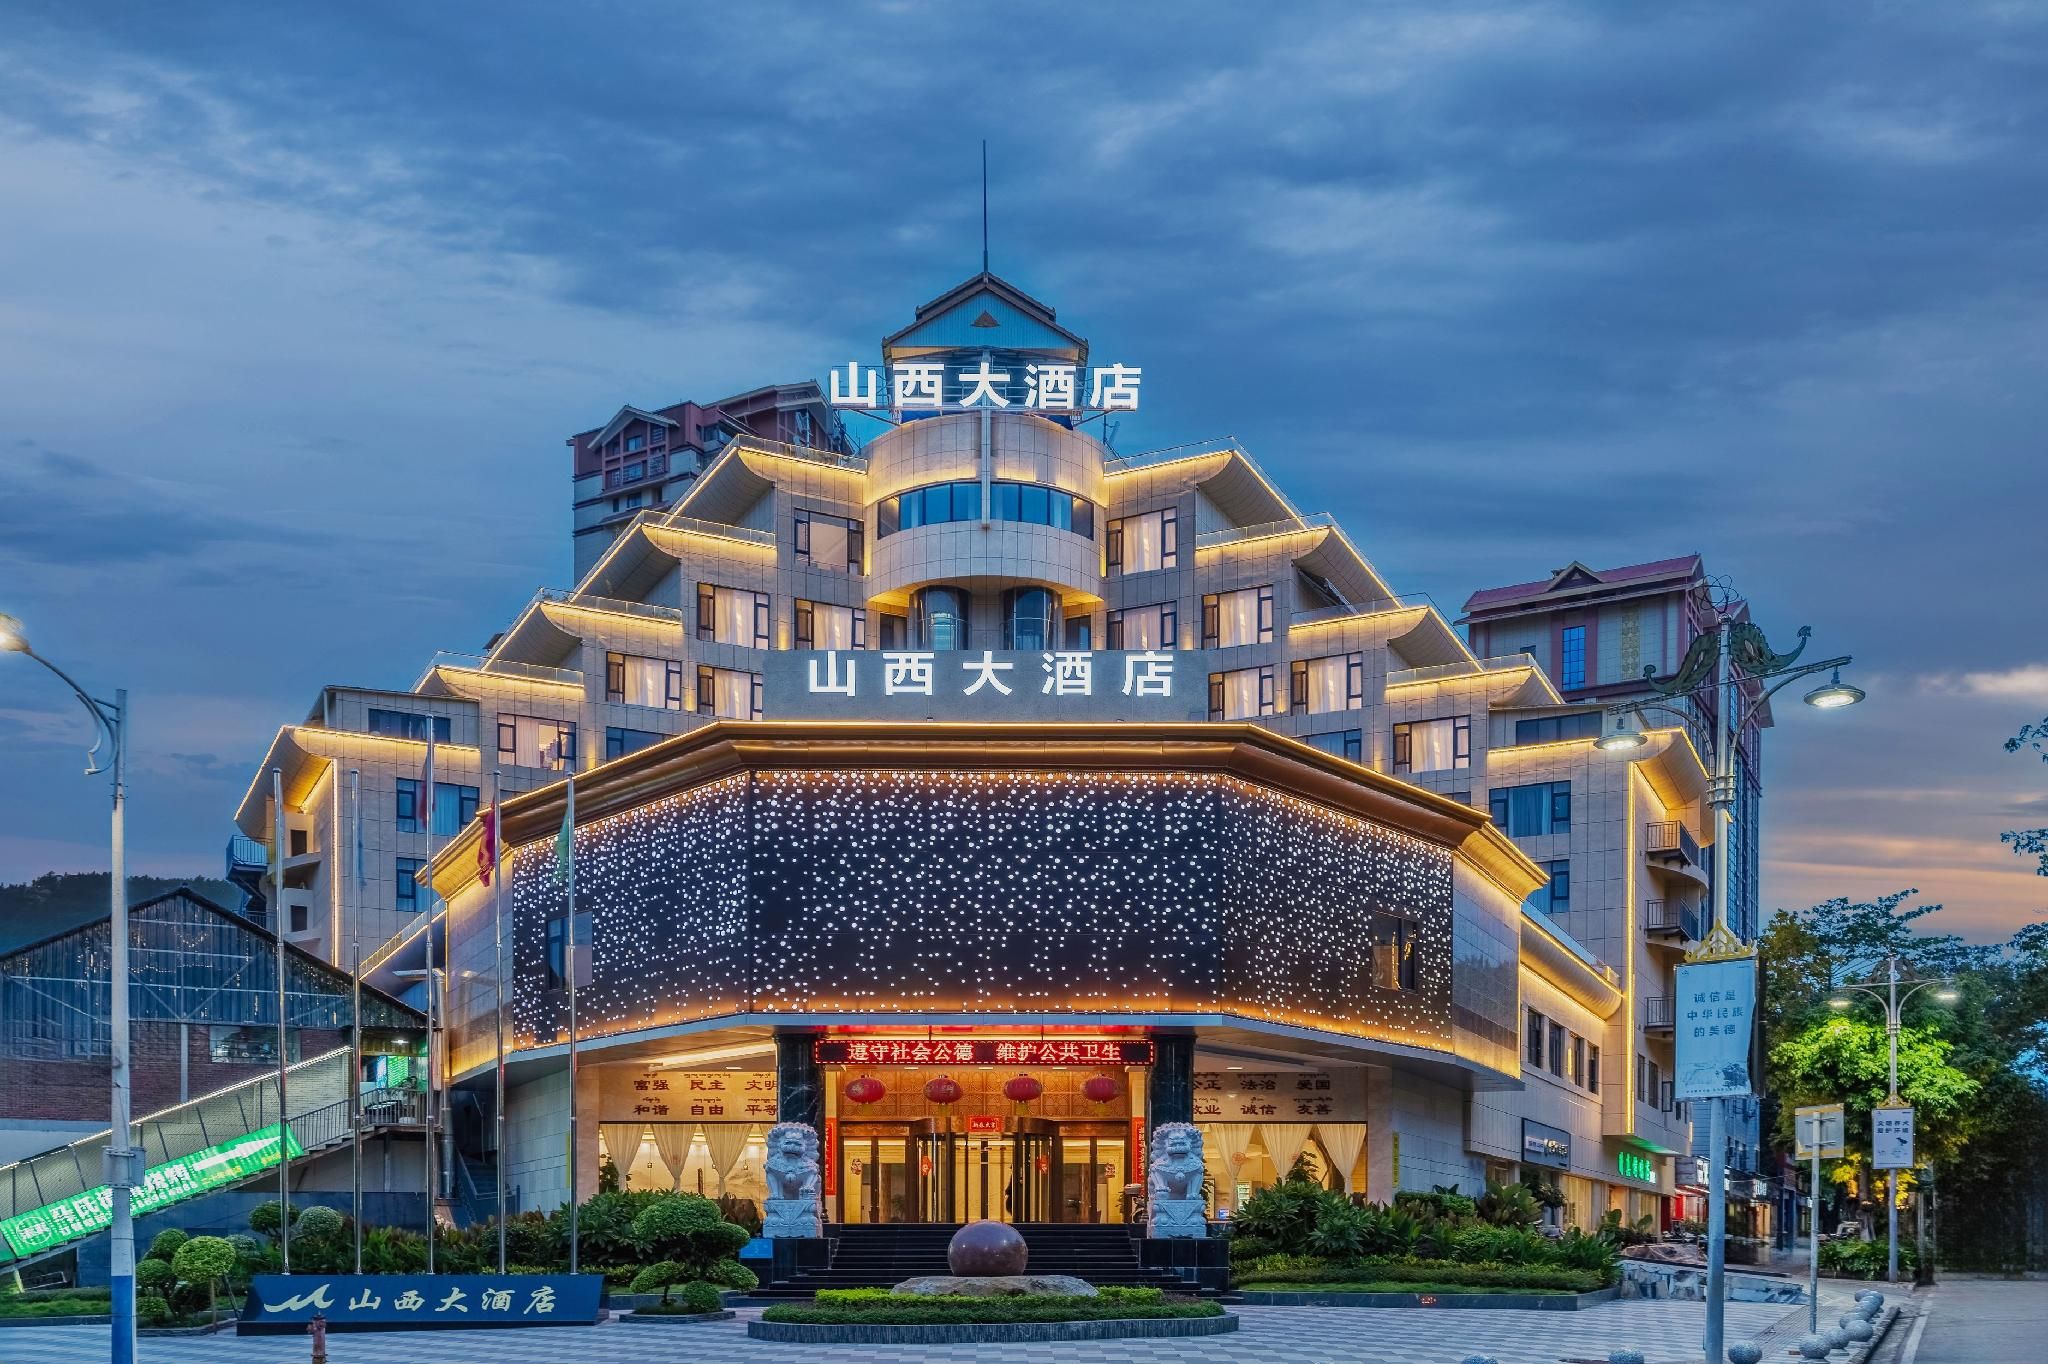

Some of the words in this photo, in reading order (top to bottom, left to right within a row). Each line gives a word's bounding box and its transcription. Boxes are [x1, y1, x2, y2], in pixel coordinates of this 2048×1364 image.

[830, 361, 1142, 410] 山西大酒店
[808, 650, 1174, 697] 山西大酒店
[1693, 989, 1736, 1004] 诚信是
[1687, 1006, 1743, 1021] 中华民族
[1693, 1024, 1736, 1038] 的美德
[848, 1042, 974, 1061] 遵守社会公德
[996, 1042, 1122, 1061] 维护公共卫生
[633, 1079, 670, 1091] 富强
[690, 1079, 726, 1091] 民主
[744, 1079, 778, 1091] 文明
[1240, 1079, 1276, 1091] 法治
[1296, 1079, 1331, 1091] 爱国
[633, 1104, 670, 1116] 和谐
[691, 1104, 724, 1116] 自由
[1240, 1104, 1277, 1115] 诚信
[1296, 1104, 1333, 1115] 友善
[348, 1285, 557, 1314] 山西大酒店
